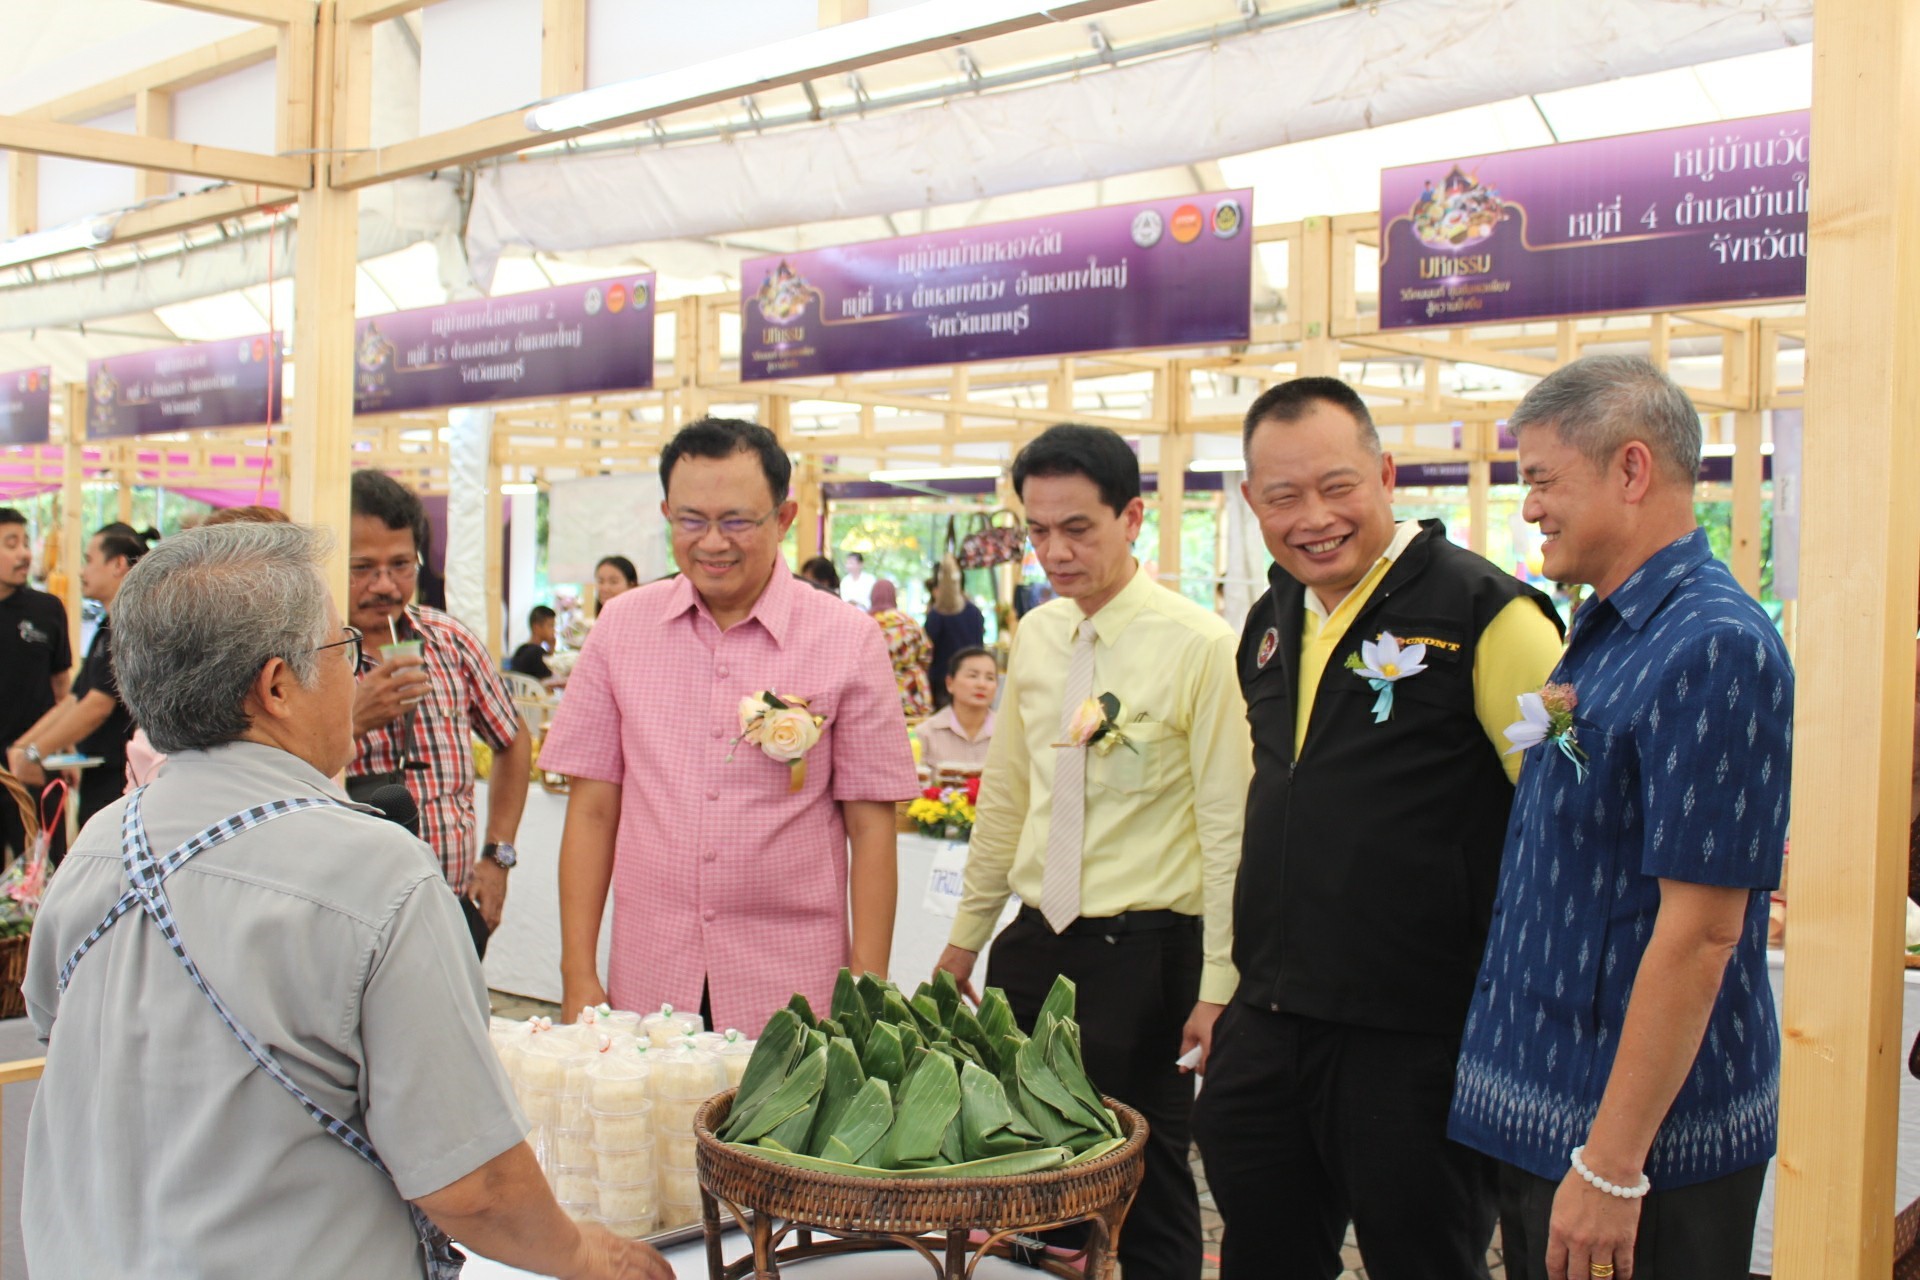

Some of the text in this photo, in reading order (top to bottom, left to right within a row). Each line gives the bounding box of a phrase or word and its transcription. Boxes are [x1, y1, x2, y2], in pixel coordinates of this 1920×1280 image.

[1568, 172, 1808, 241] หมู่ที่ 4 ตำบลบ้านใ
[1420, 254, 1491, 279] มหกรรม
[884, 292, 903, 312] 14
